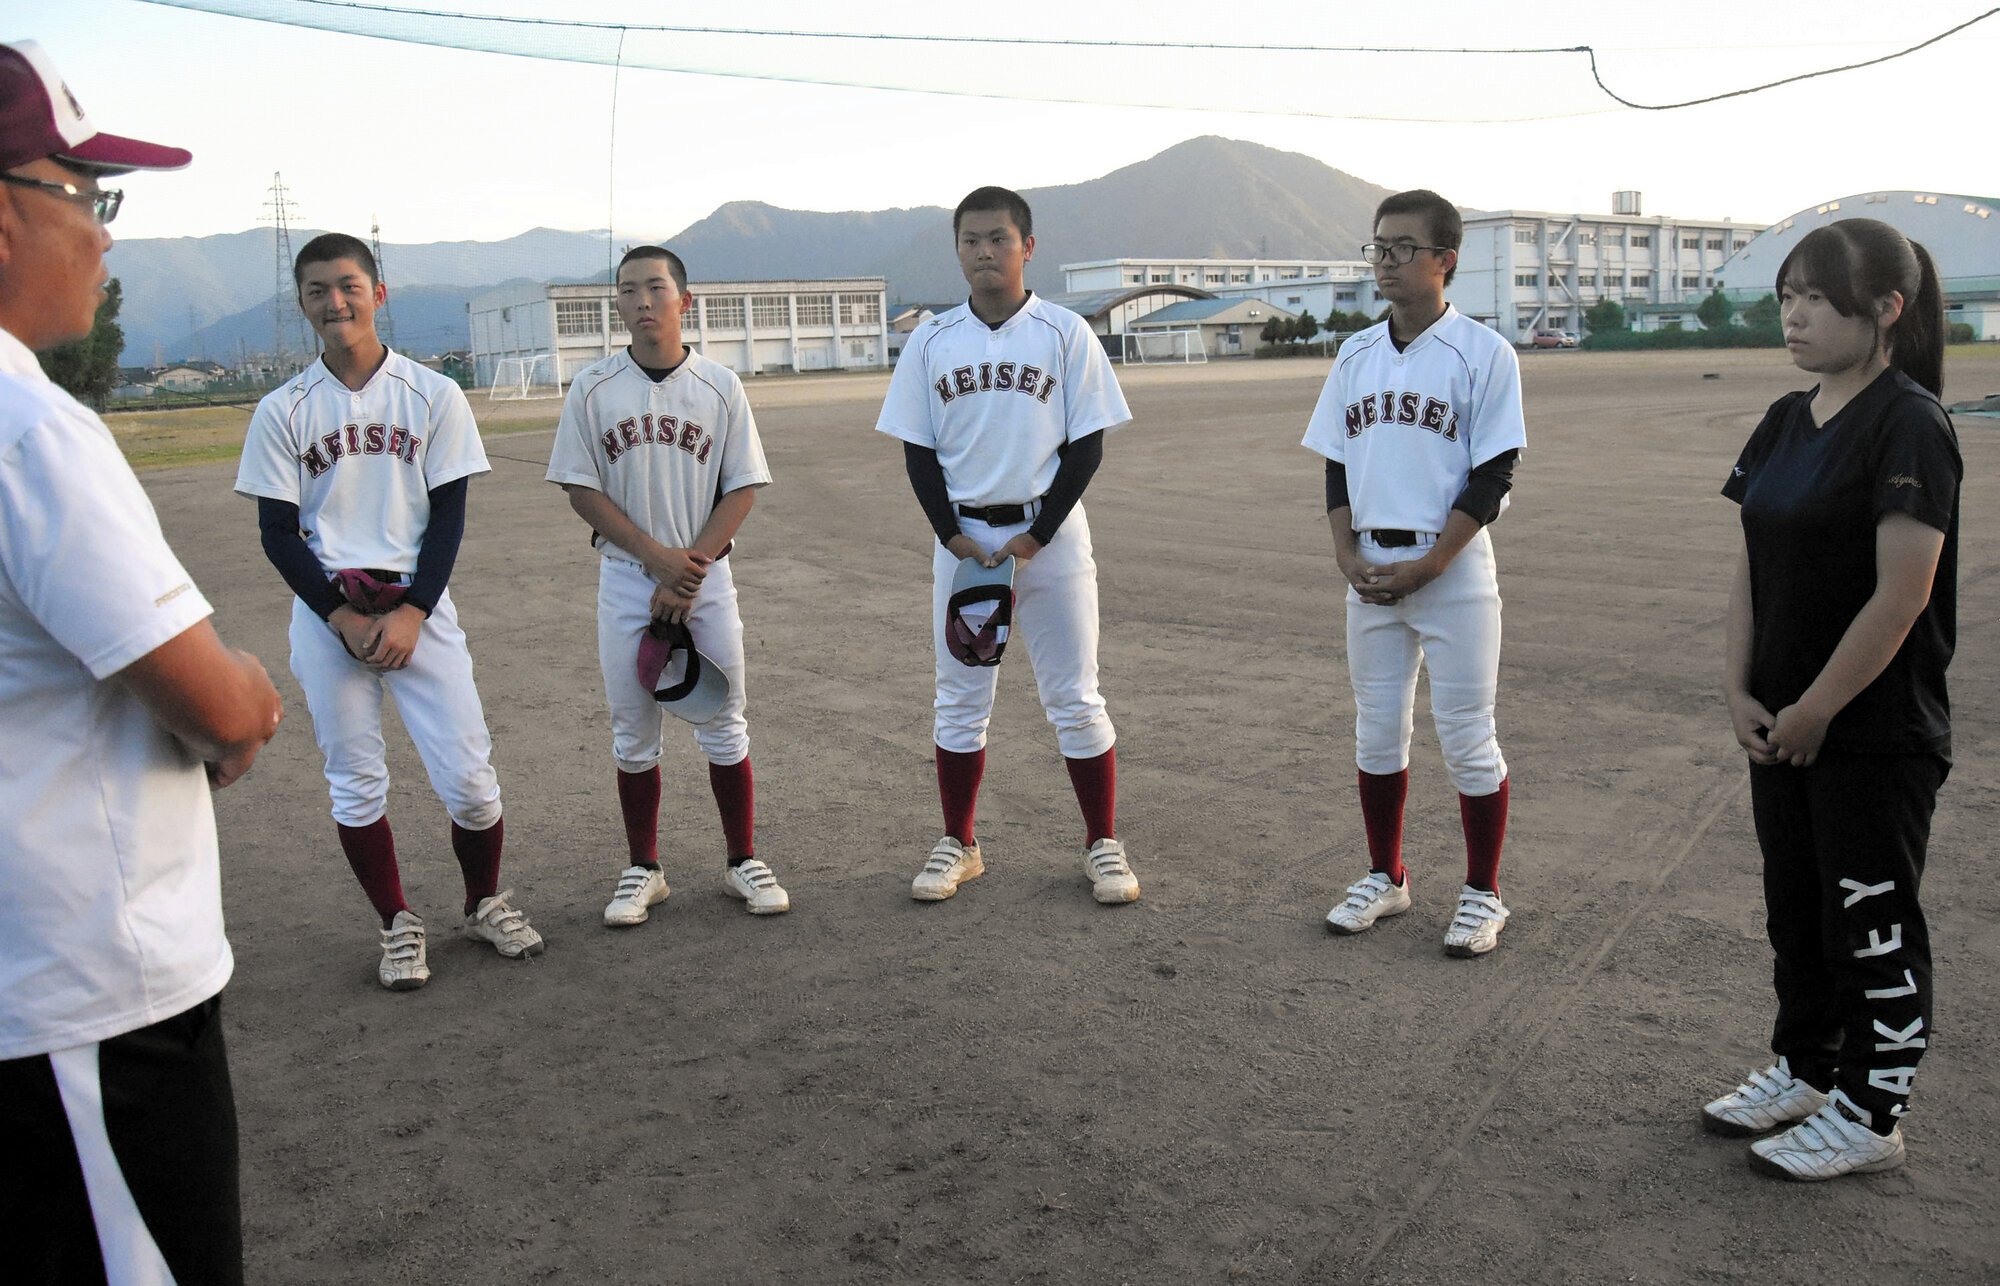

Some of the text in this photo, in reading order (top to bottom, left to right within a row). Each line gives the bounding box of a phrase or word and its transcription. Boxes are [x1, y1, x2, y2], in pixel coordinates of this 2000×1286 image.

[935, 361, 1057, 406] MEISEI
[601, 413, 713, 465] MEISEI
[1345, 390, 1459, 442] MEISEI
[300, 423, 422, 479] MEISEI
